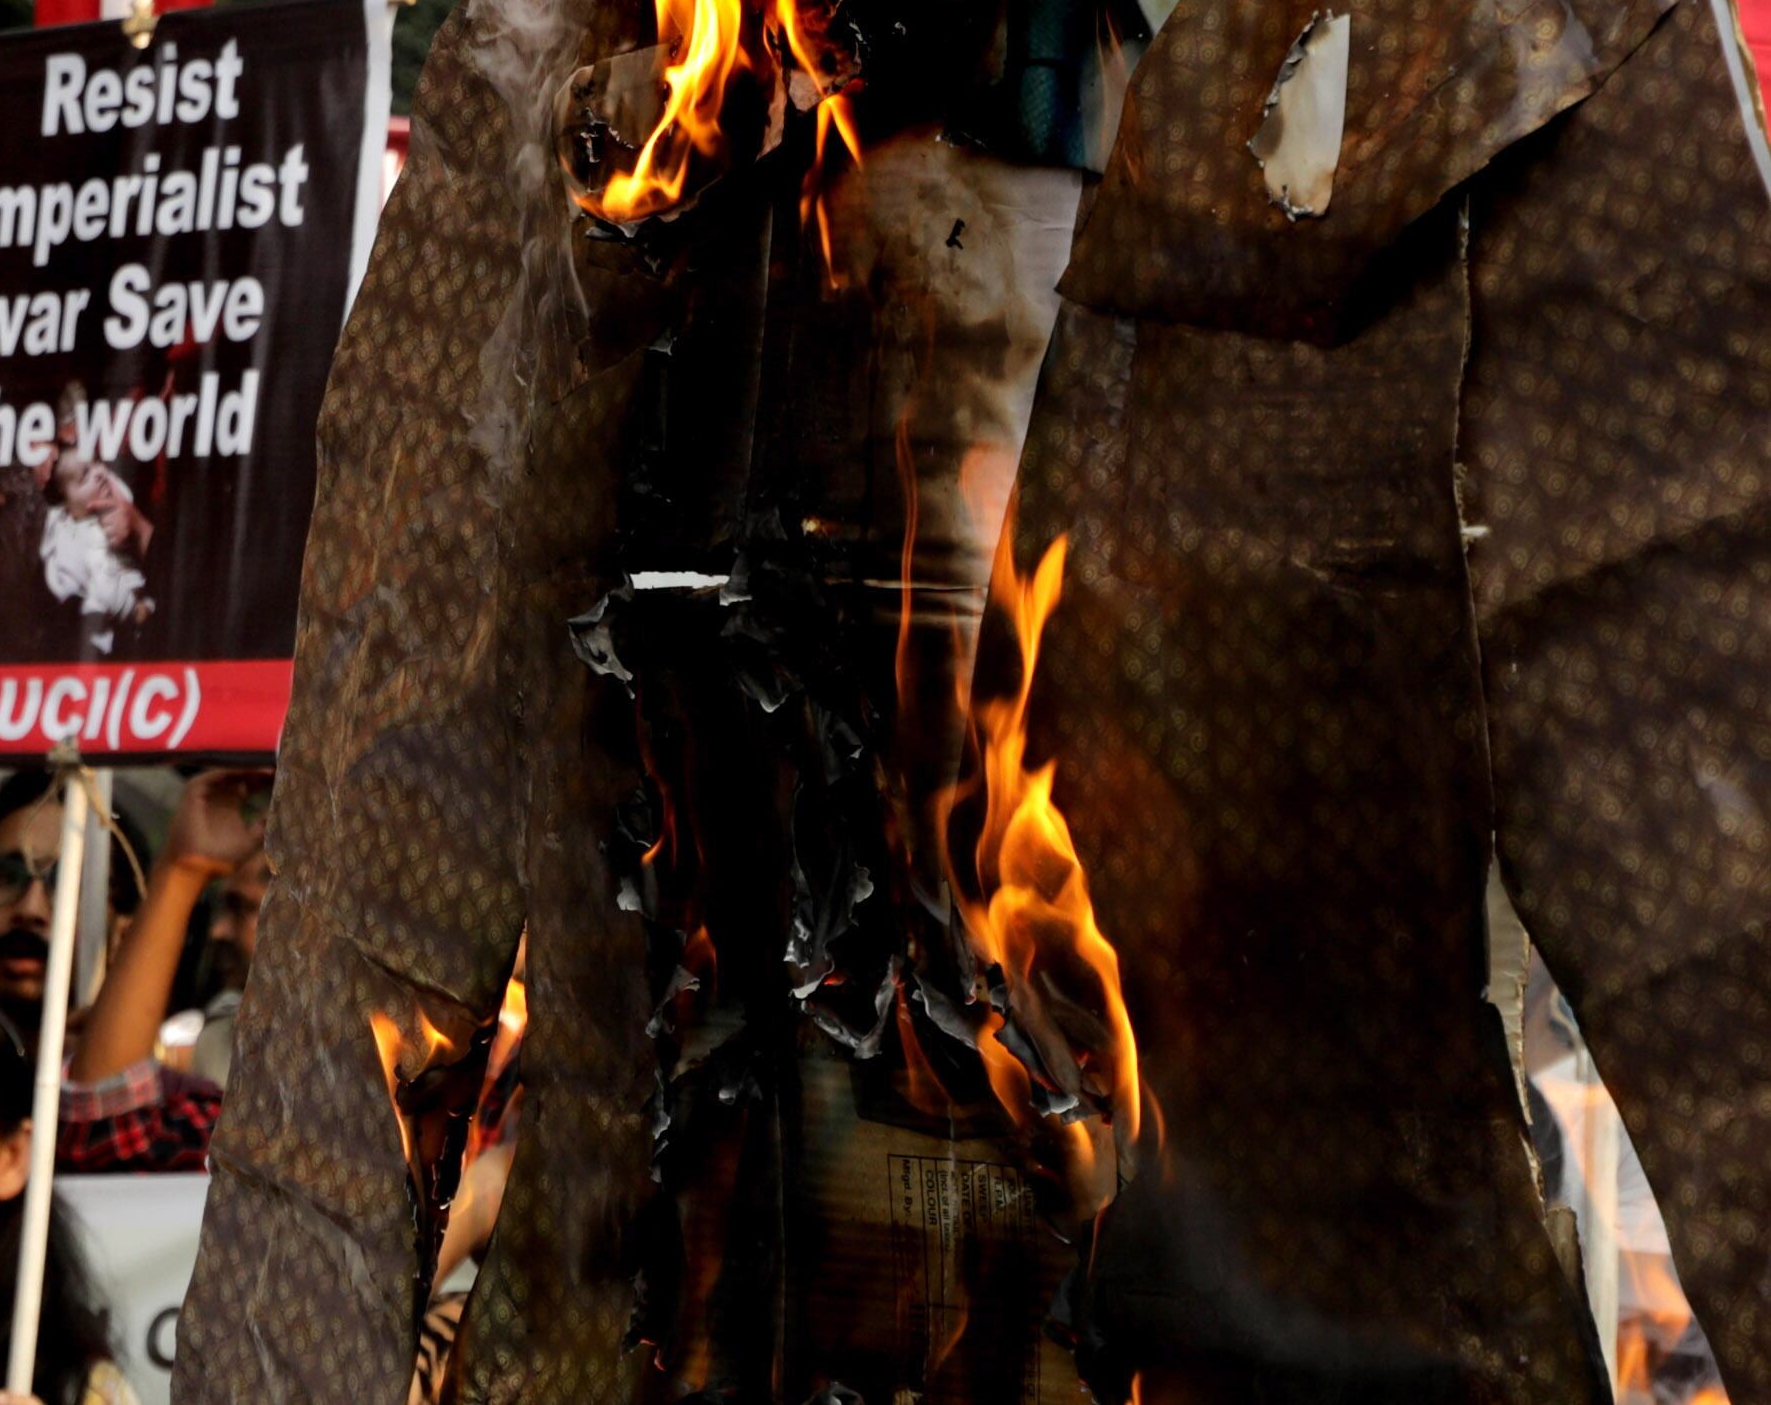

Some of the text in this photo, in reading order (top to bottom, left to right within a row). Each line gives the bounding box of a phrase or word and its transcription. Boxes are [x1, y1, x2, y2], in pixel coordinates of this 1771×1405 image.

[42, 38, 244, 137] Resist
[103, 264, 265, 353] Save
[74, 369, 260, 463] world
[925, 1169, 938, 1226] COLOUR
